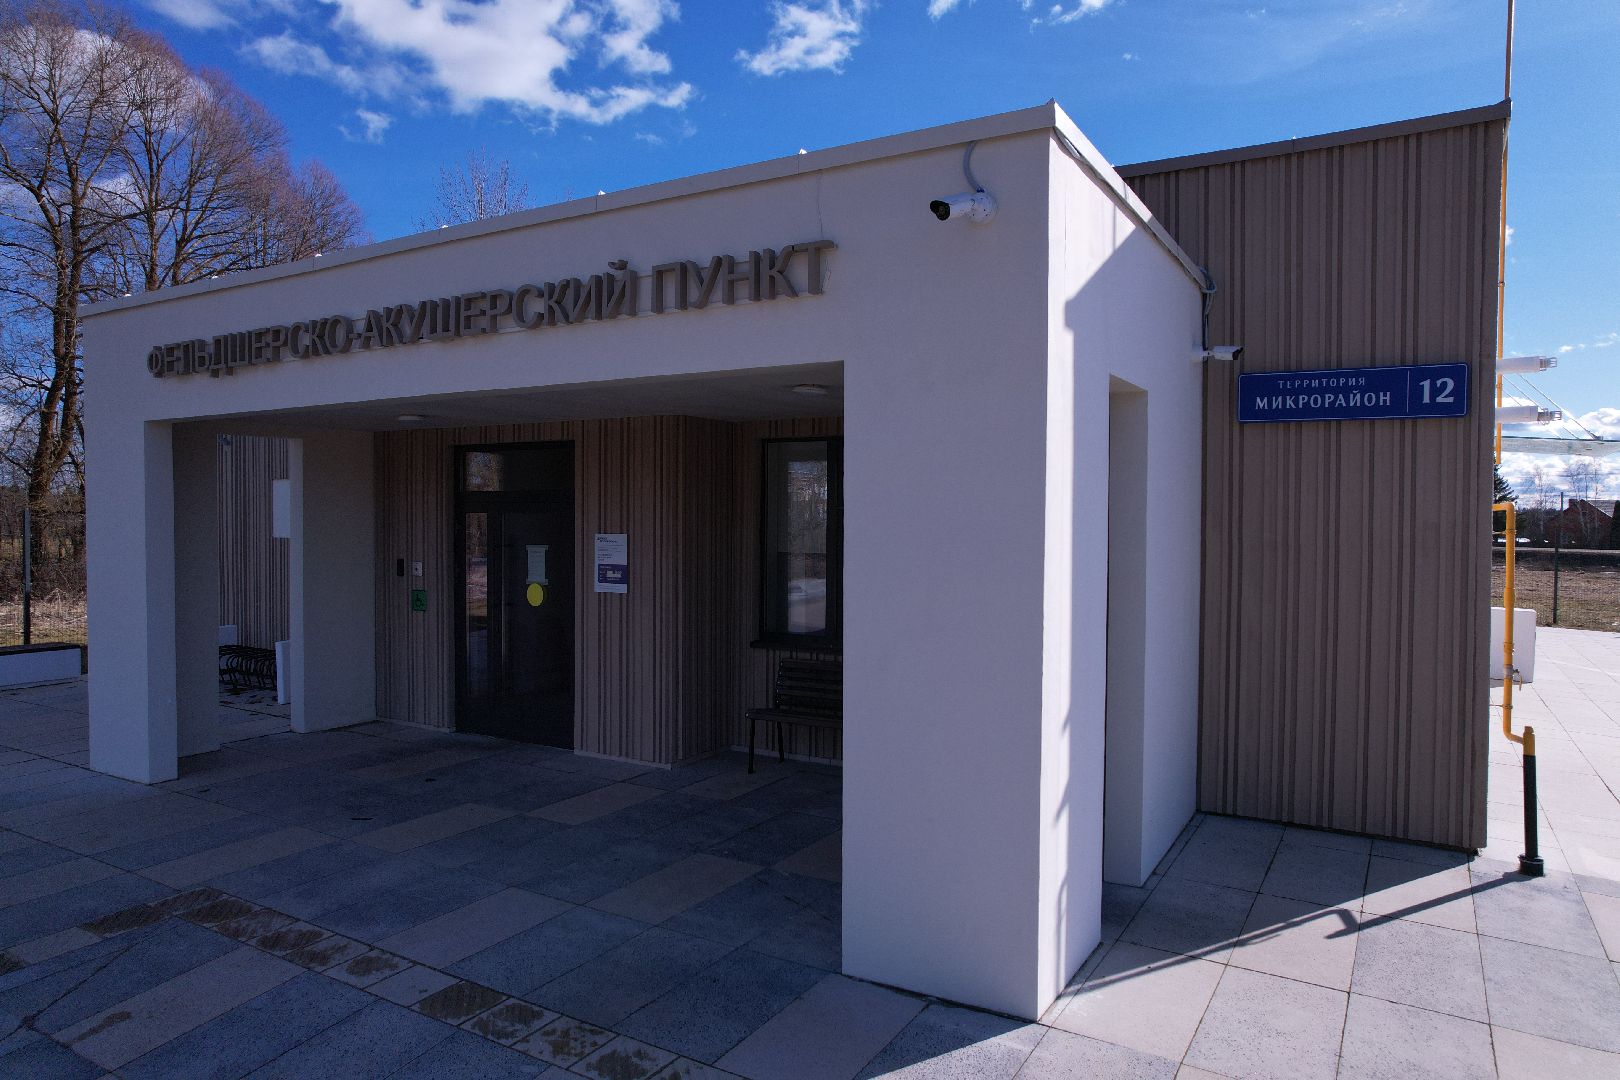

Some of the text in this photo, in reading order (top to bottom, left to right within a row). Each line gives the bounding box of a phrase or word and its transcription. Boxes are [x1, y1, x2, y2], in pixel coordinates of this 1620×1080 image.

[147, 240, 838, 378] ФЕЛЬДШЕРСКО-АКУШЕРСКИЙ ПУНКТ
[1255, 377, 1455, 410] МИКРОРАЙОН 12
[1278, 377, 1366, 389] ТЕРРИТОРИЯ
